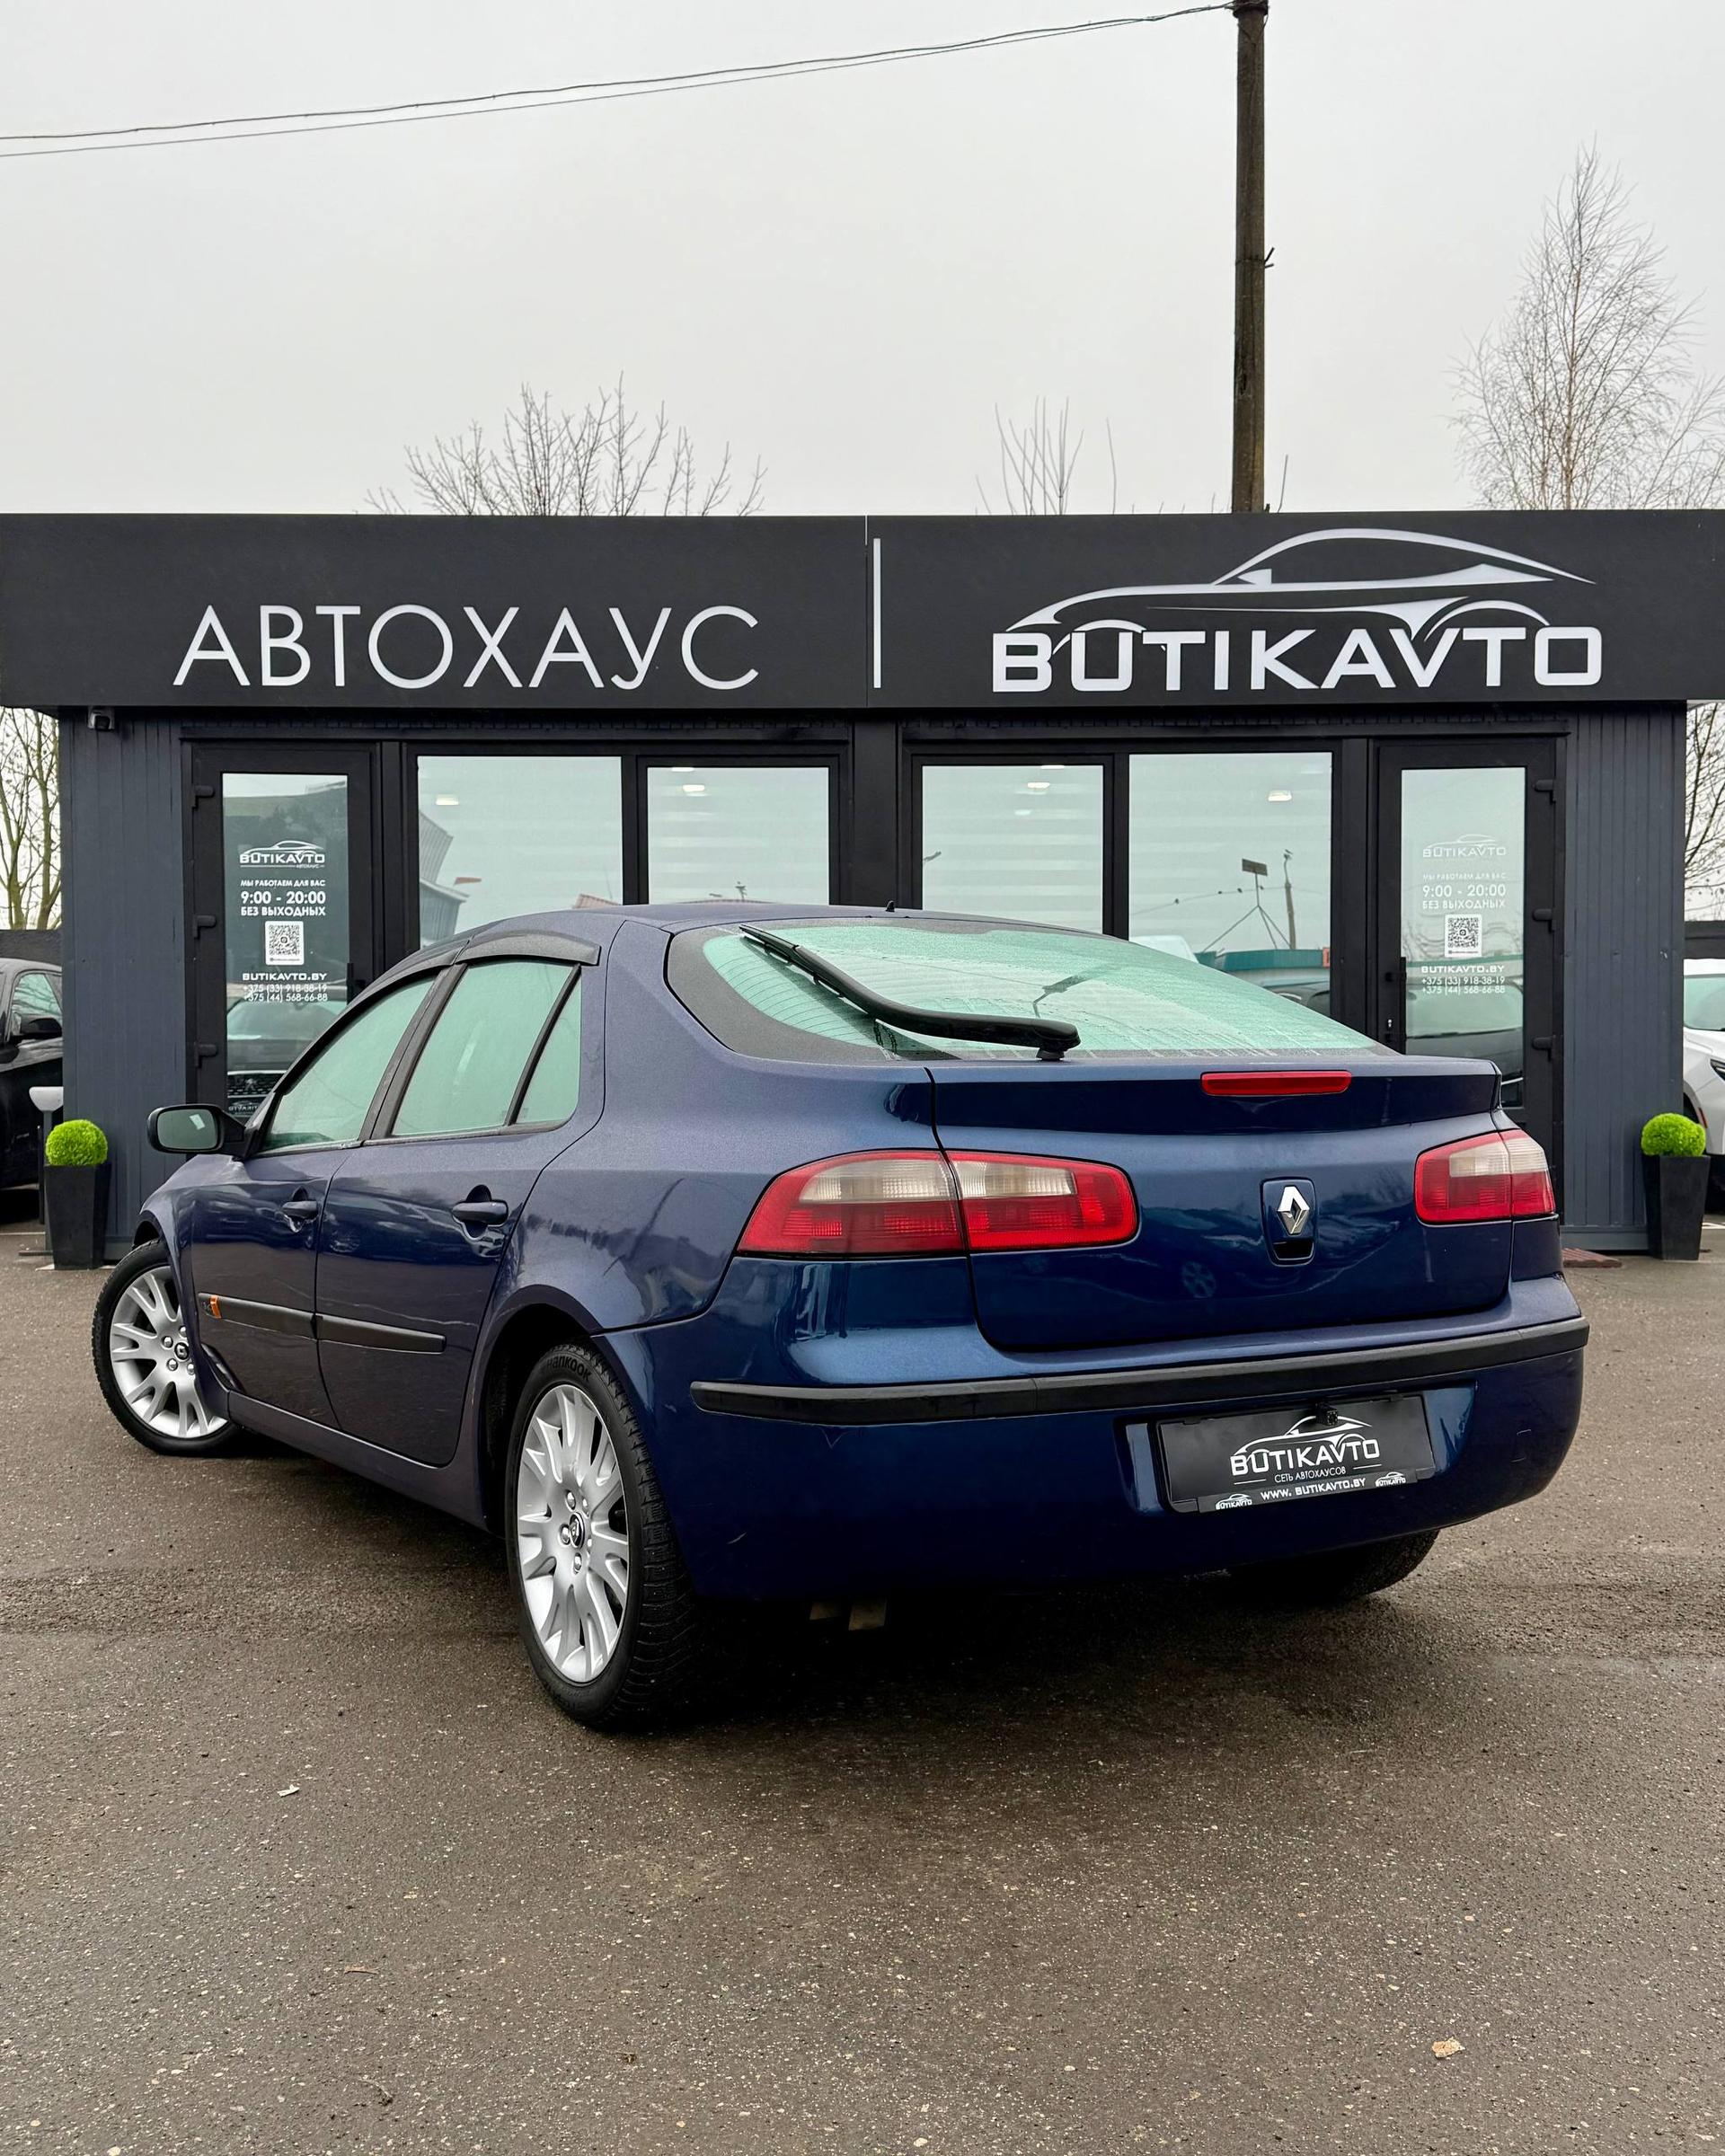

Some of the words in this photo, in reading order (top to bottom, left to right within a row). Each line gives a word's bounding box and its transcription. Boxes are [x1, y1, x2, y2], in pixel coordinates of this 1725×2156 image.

[172, 604, 760, 690] АВТОХАУС
[992, 625, 1603, 693] BUTIKAVTO
[1423, 847, 1506, 857] BUTIKAVTO
[240, 853, 325, 863] BUTIKAVTO
[293, 879, 309, 888] ДЛЯ
[1422, 884, 1453, 898] 9:00
[1467, 883, 1507, 897] 20:00
[241, 890, 272, 905] 9:00
[286, 890, 326, 905] 20:00
[1422, 899, 1439, 909] БЕЗ
[1442, 899, 1506, 910] ВЫХОДНЫХ
[241, 906, 260, 916] БЕЗ
[261, 906, 326, 917] ВЫХОДНЫХ
[1421, 976, 1443, 985] +375
[1445, 976, 1462, 987] (33)
[1463, 976, 1506, 985] 918-38-19
[267, 984, 284, 994] (33)
[286, 984, 328, 993] 918-38-19
[1421, 985, 1443, 994] +375
[1445, 985, 1462, 996] (44)
[1463, 985, 1507, 994] 568-66-88
[267, 993, 284, 1003] (44)
[286, 993, 329, 1003] 568-66-88
[1230, 1439, 1380, 1476] BUTIKAVTO
[1274, 1472, 1294, 1483] СЕТЬ
[1295, 1466, 1347, 1482] АВТОХАУСОВ
[1376, 1476, 1407, 1487] BUTIKAVTO
[1260, 1489, 1292, 1501] WWW.
[1296, 1478, 1366, 1496] BUTIKAVTO.BY
[1216, 1498, 1253, 1510] BUTIKAVTO
